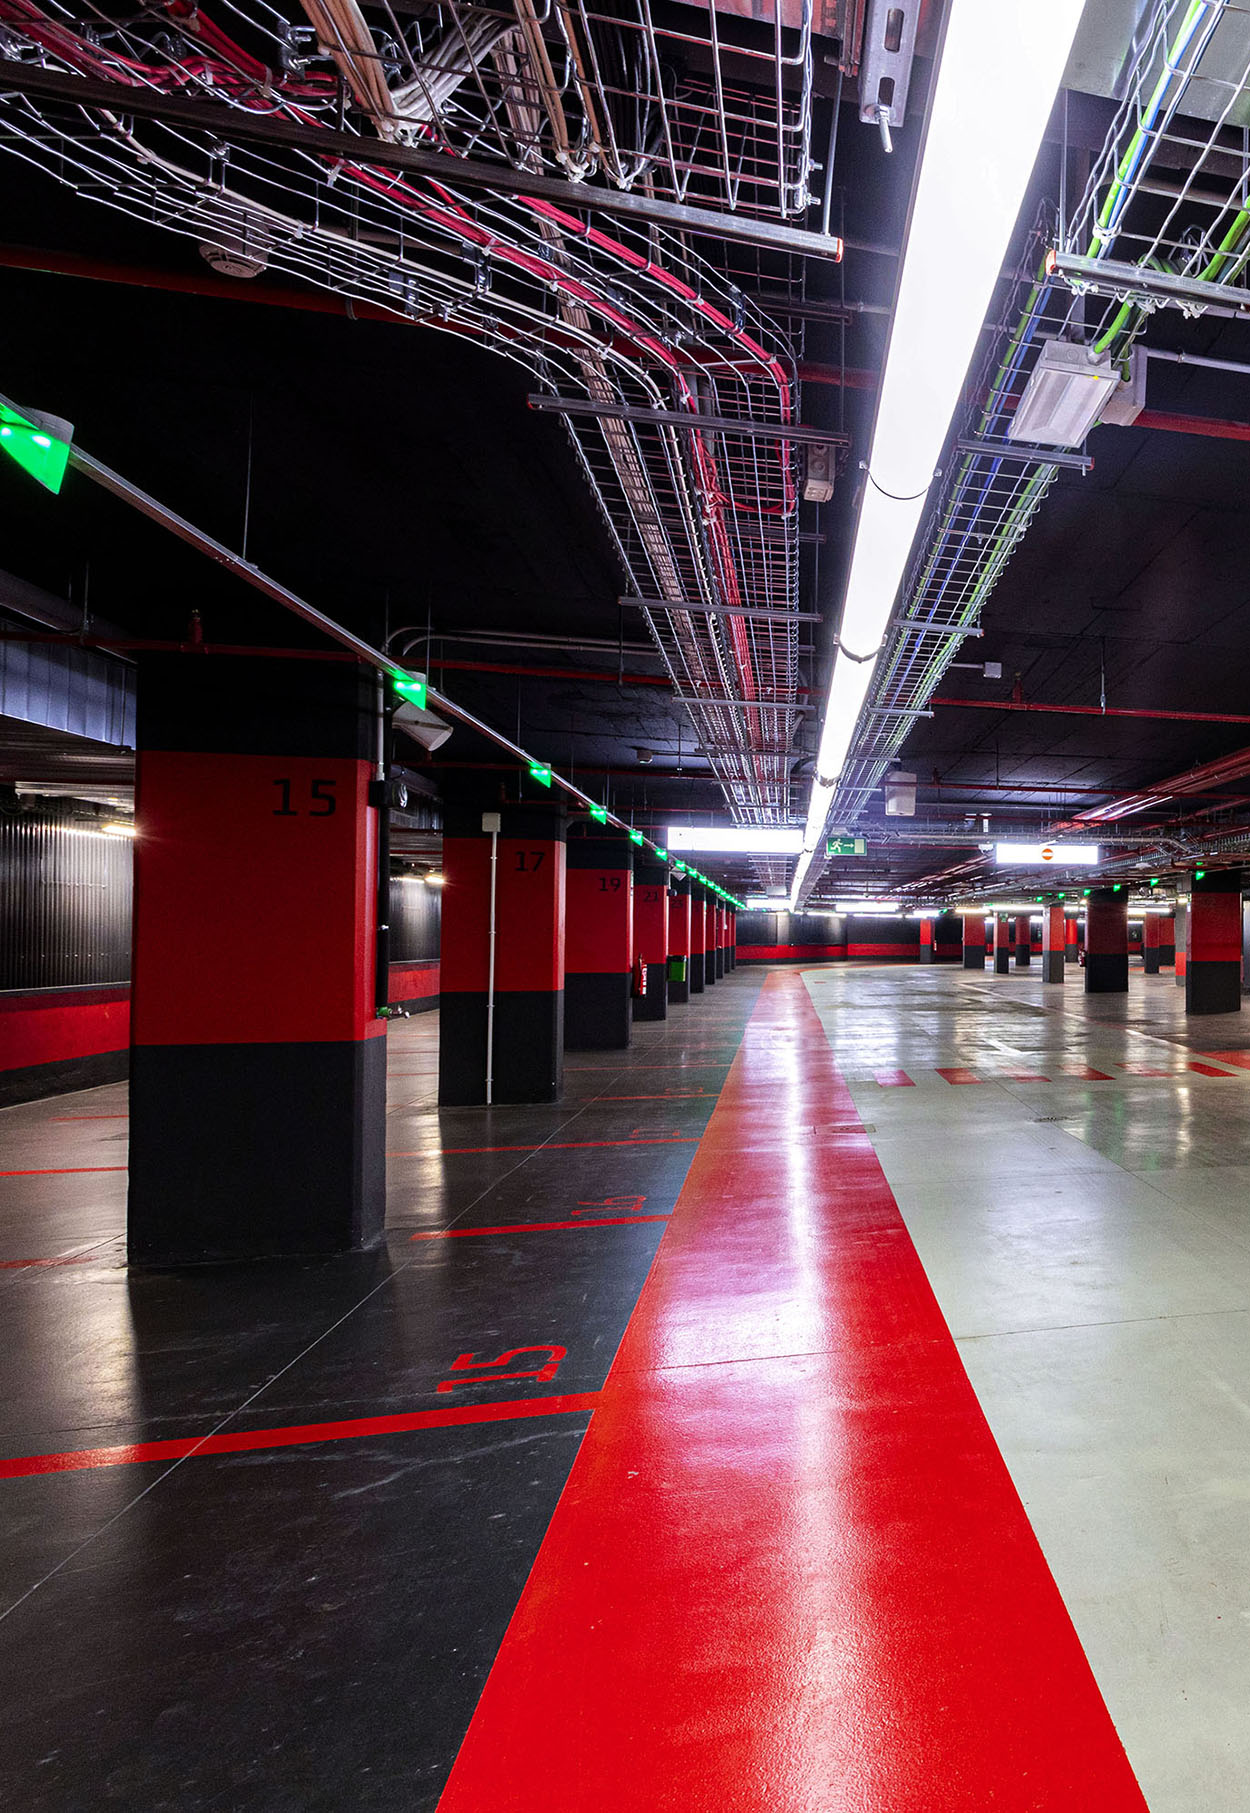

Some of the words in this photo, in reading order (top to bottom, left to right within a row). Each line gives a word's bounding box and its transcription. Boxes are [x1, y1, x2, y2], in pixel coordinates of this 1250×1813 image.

[272, 778, 336, 816] 15
[514, 851, 546, 872] 17
[599, 877, 621, 892] 19
[643, 891, 658, 901] 21
[436, 1345, 567, 1393] 15
